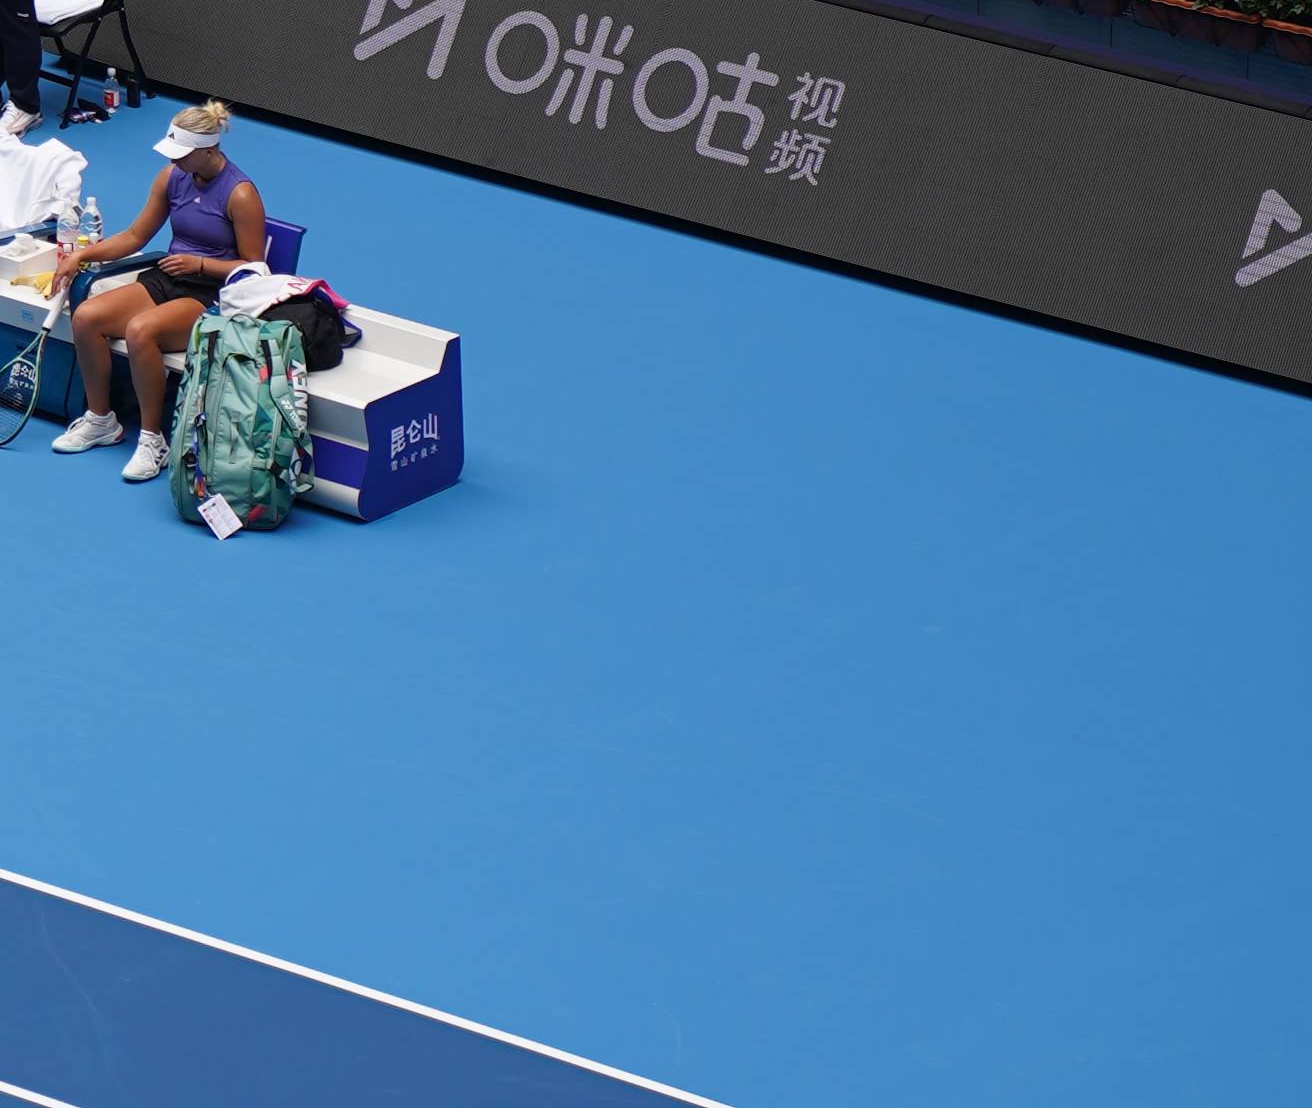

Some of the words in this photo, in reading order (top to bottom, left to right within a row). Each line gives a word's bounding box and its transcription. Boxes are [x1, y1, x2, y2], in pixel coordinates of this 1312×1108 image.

[484, 10, 780, 167] 咪咕
[764, 71, 846, 186] 视频
[391, 413, 438, 460] 昆仑山
